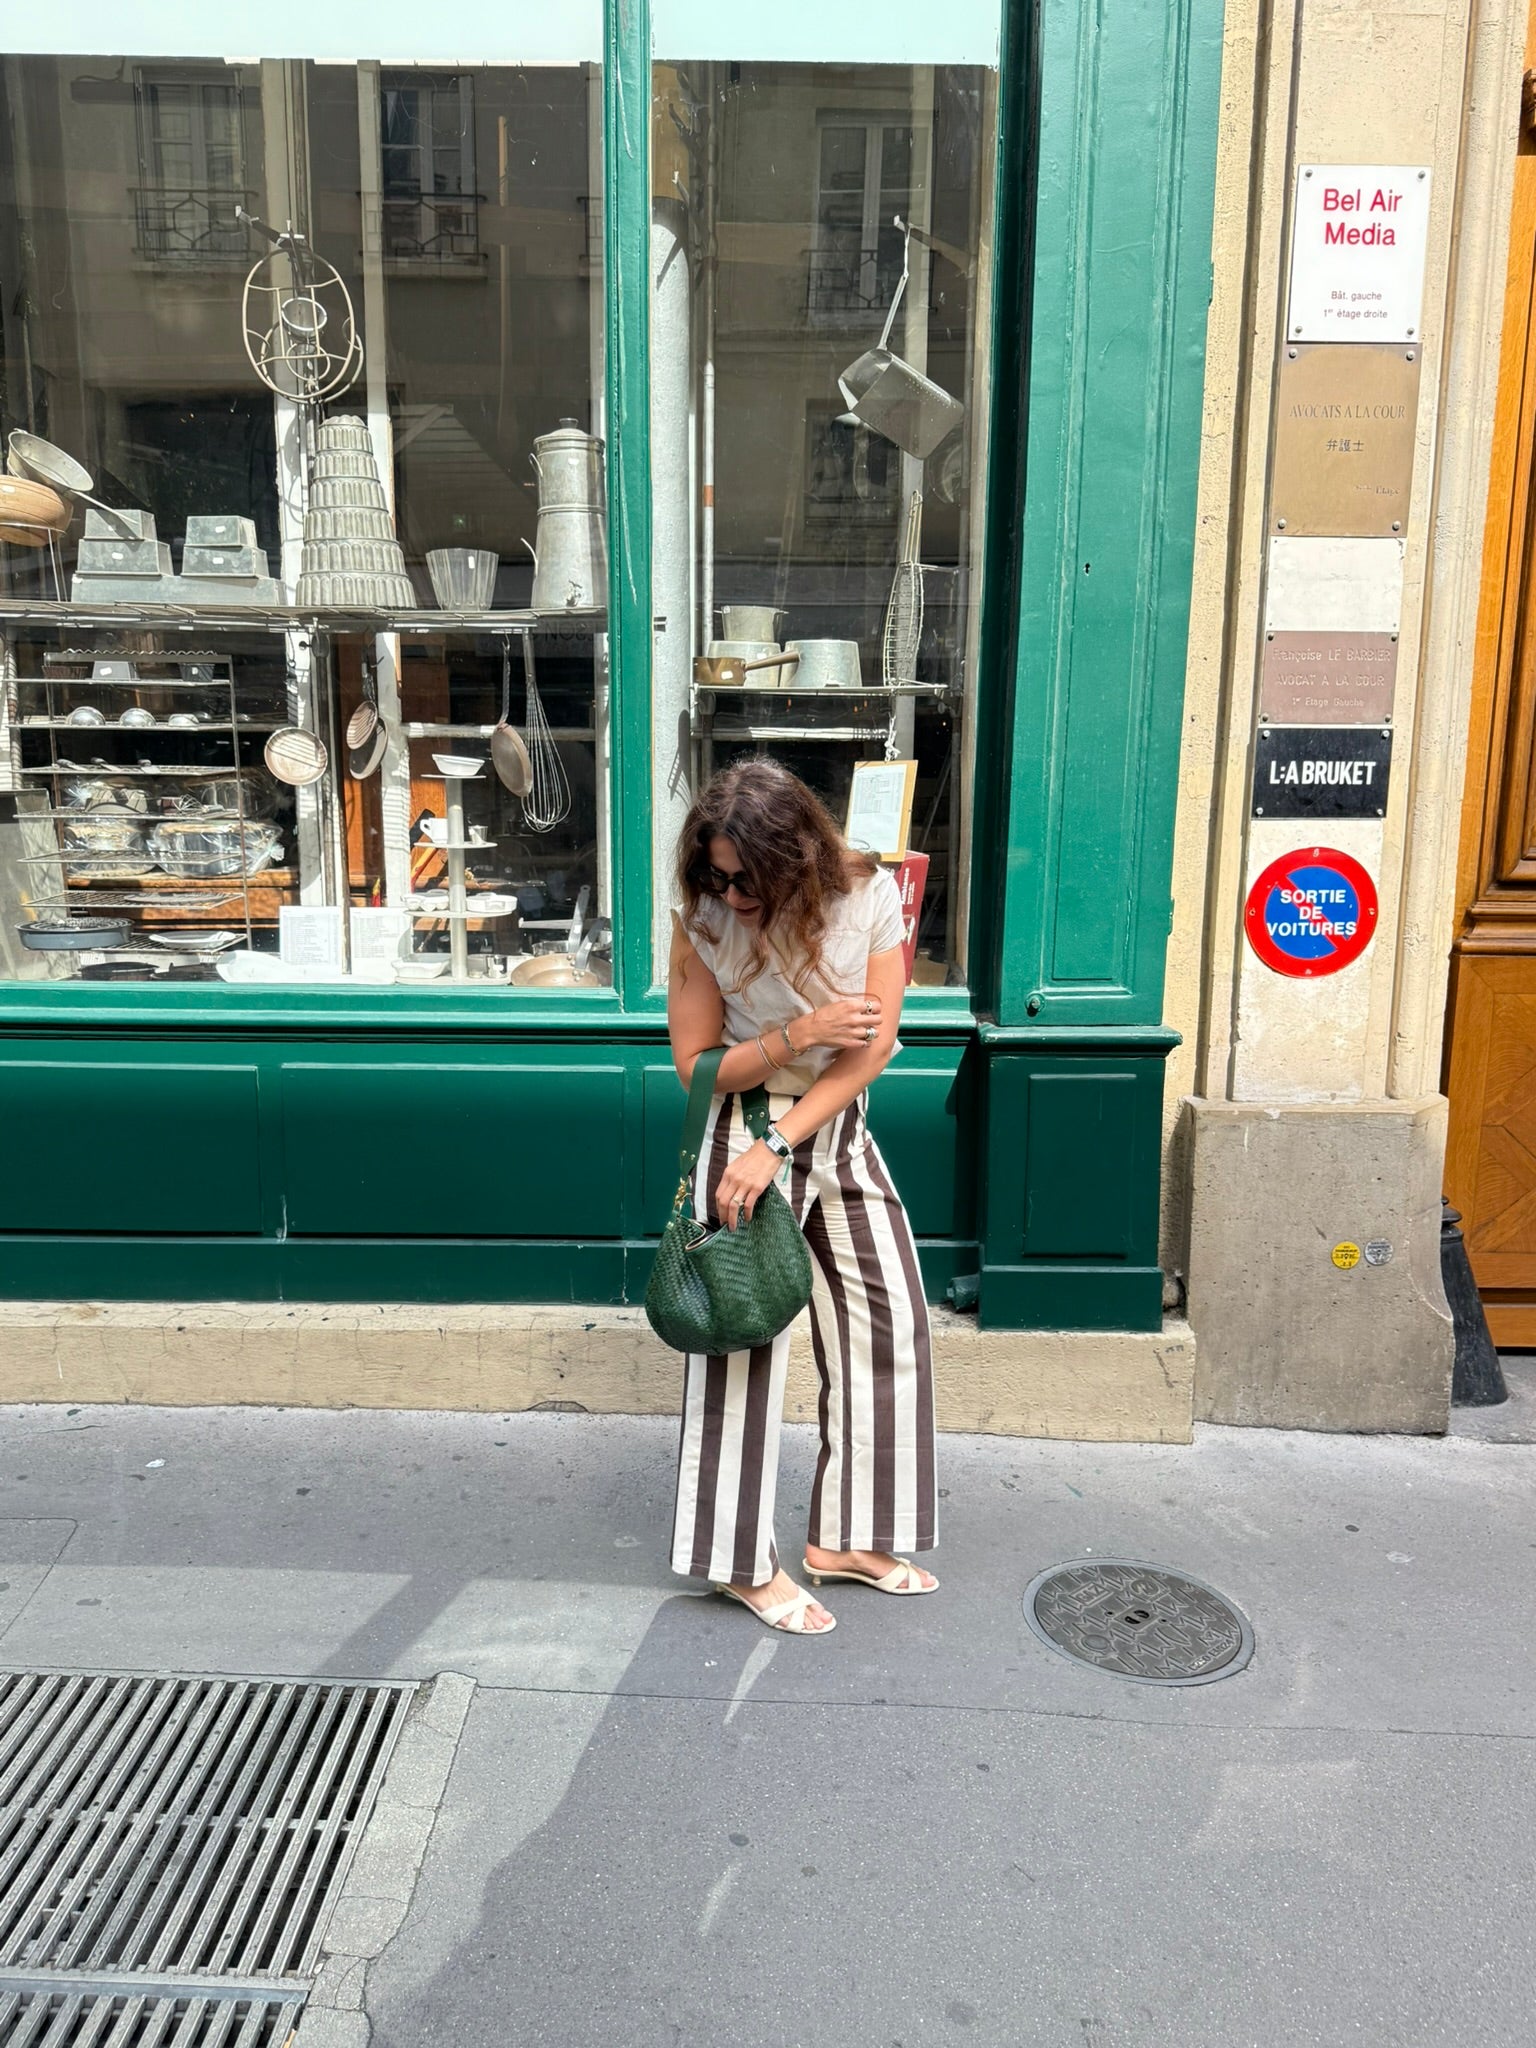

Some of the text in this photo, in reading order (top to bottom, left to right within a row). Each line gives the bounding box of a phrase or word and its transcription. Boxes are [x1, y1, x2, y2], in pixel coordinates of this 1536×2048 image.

[1323, 188, 1403, 212] Bel Air
[1325, 222, 1396, 245] Media
[1351, 291, 1382, 302] gauche
[1337, 309, 1361, 320] étage
[1363, 309, 1388, 318] droite
[1289, 404, 1405, 419] AVOCATS A LA COUR
[1326, 438, 1365, 452] 弁護士
[1328, 649, 1341, 661] LE
[1275, 673, 1385, 687] AVOCAT A LA COUR
[1269, 760, 1377, 785] L:A BRUKET
[1280, 889, 1346, 904] SORTIE
[1299, 906, 1323, 920] DE
[1266, 921, 1357, 936] VOITURES
